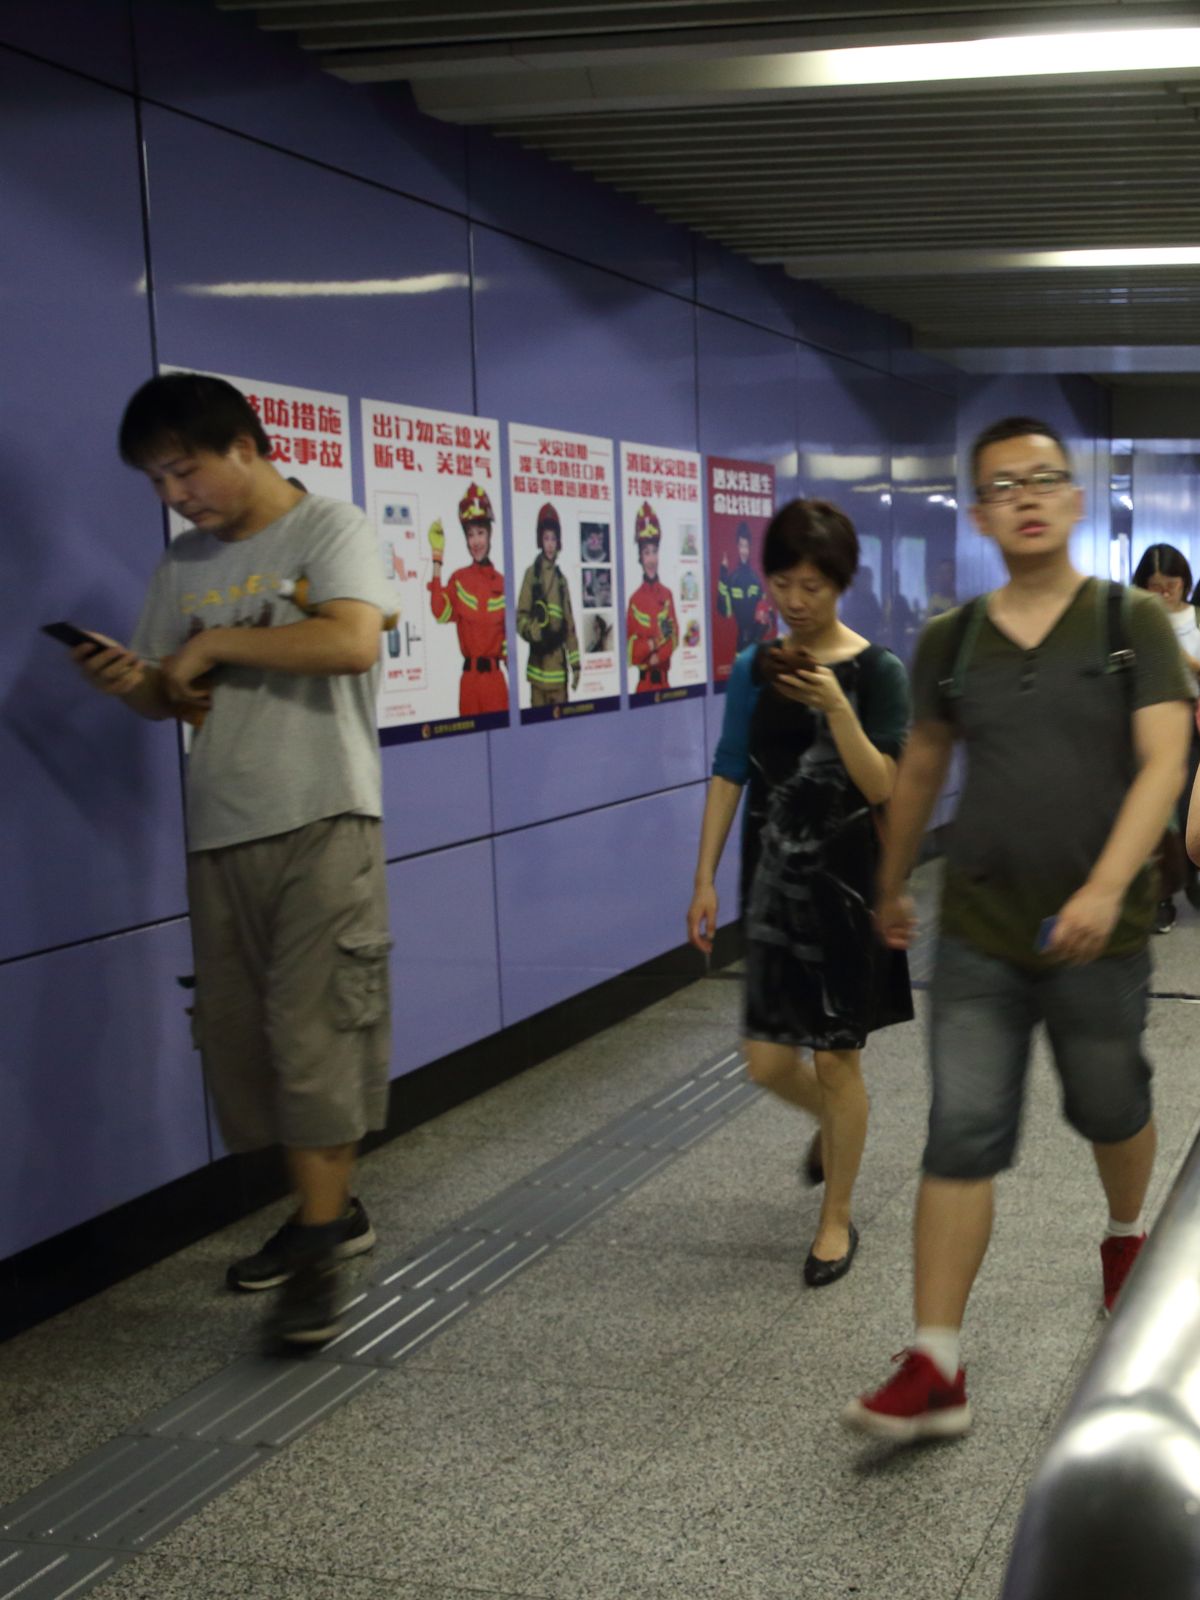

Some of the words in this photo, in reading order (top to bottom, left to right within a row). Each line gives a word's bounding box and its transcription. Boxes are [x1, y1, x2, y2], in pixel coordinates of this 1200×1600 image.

[373, 413, 491, 451] 出门勿忘熄火
[266, 434, 343, 469] 灾事故
[374, 443, 492, 478] 断电、关燃气
[626, 452, 698, 479] 消除火灾隐患
[628, 477, 698, 502] 共创平安社区
